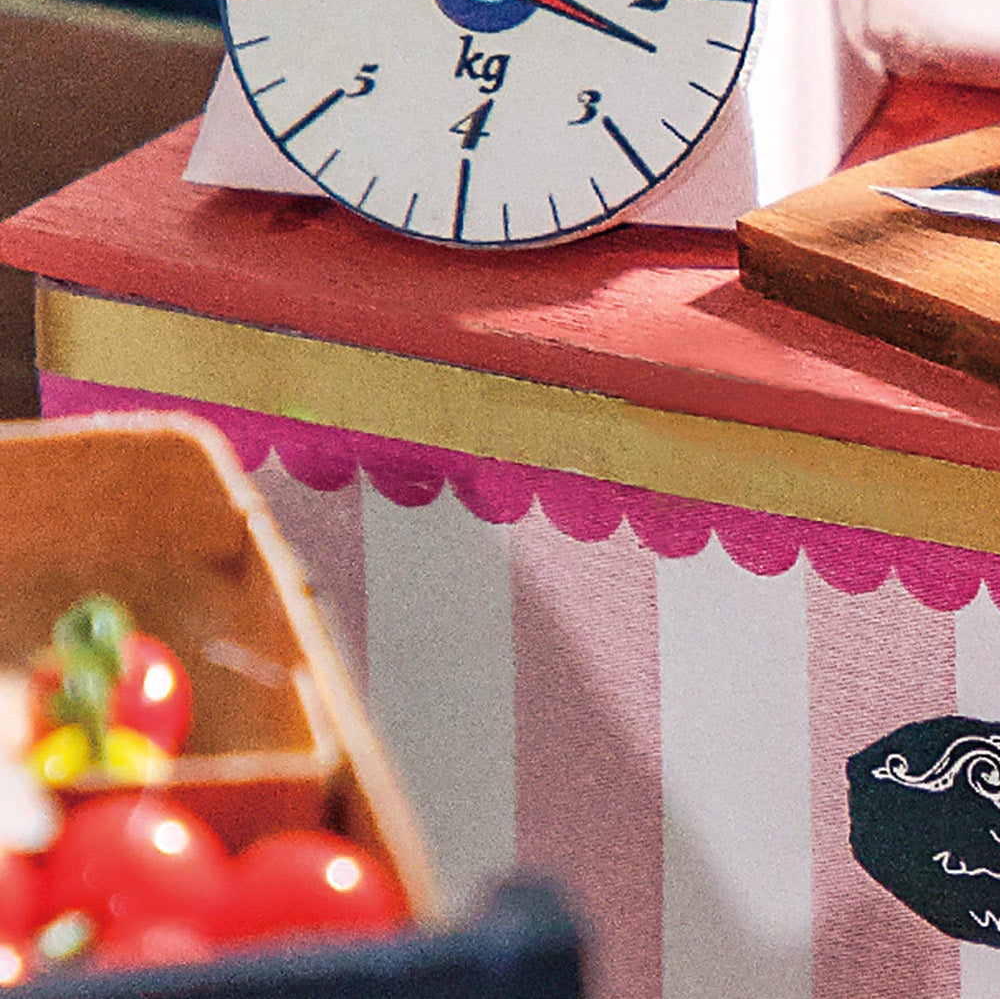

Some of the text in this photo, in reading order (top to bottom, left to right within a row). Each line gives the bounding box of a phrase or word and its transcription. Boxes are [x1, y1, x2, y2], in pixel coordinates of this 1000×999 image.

[345, 64, 379, 97] 5
[453, 35, 511, 94] kg
[450, 98, 495, 150] 4
[567, 89, 601, 125] 3
